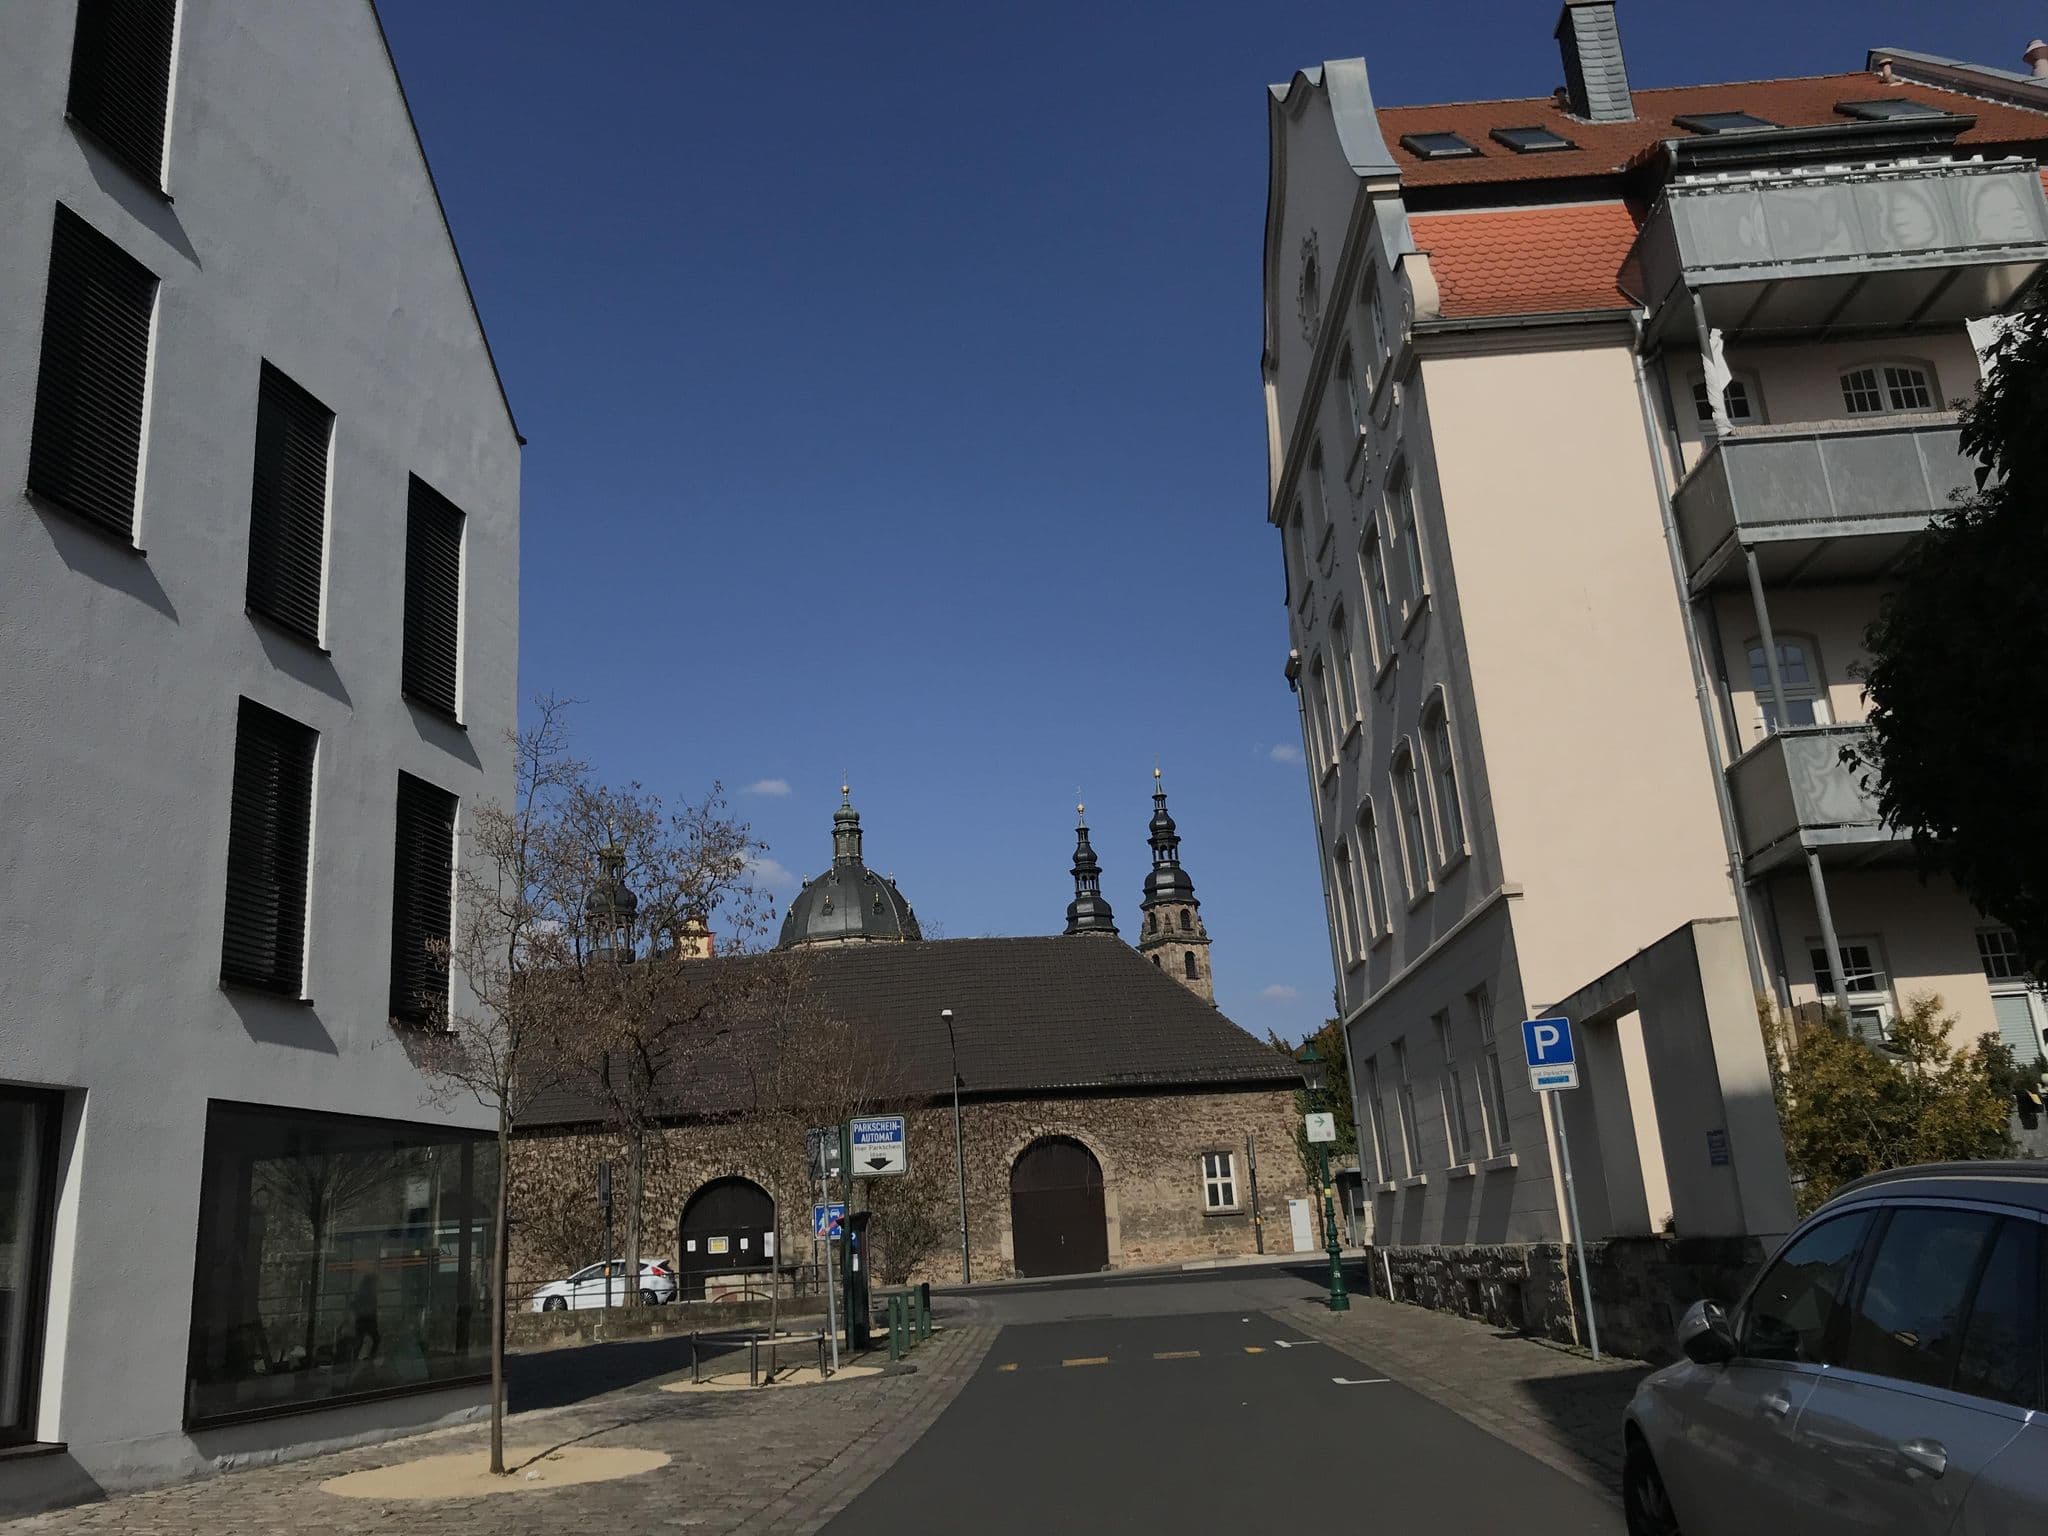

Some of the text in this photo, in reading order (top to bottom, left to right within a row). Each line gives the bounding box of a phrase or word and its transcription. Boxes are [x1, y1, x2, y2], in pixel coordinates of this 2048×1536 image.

[1534, 1025, 1560, 1060] P
[854, 1121, 901, 1132] PARKSCHEIN-
[861, 1132, 893, 1142] AUTOMAT
